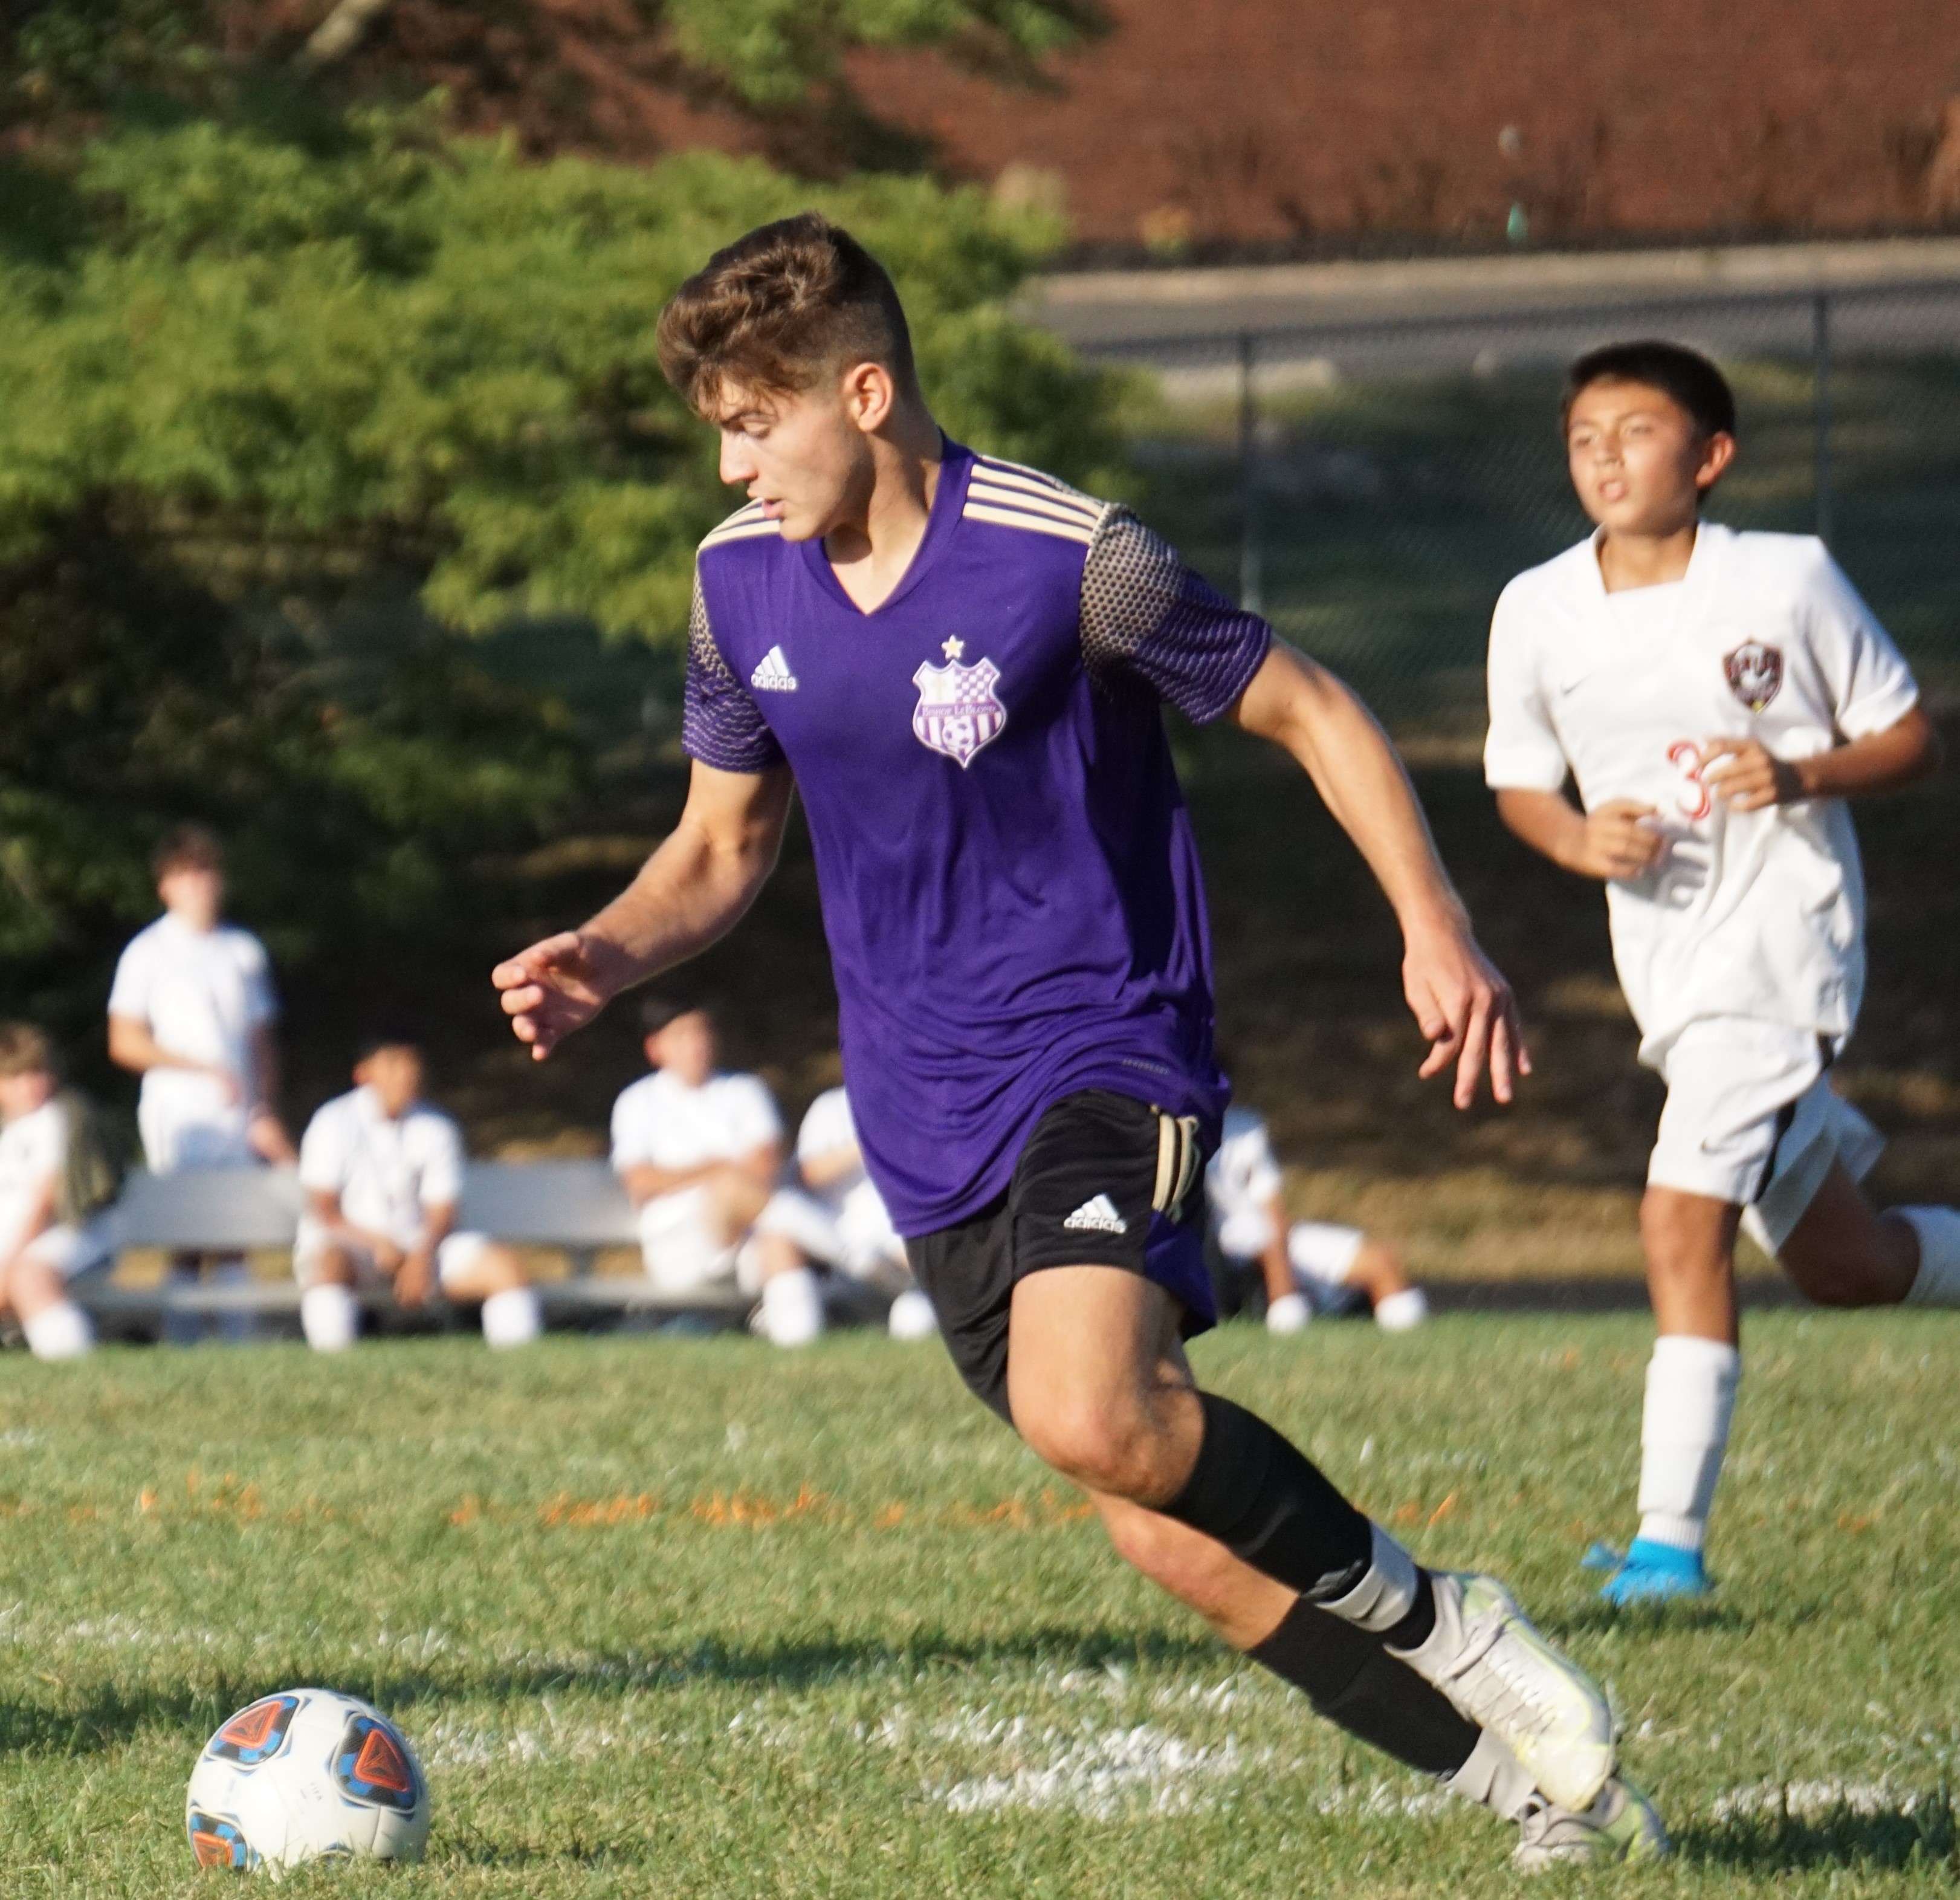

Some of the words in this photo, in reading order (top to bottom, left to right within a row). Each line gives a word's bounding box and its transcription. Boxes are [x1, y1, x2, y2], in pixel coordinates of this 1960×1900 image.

[751, 673, 797, 691] adidas
[1666, 739, 1711, 822] 3
[1063, 1216, 1126, 1234] adidas
